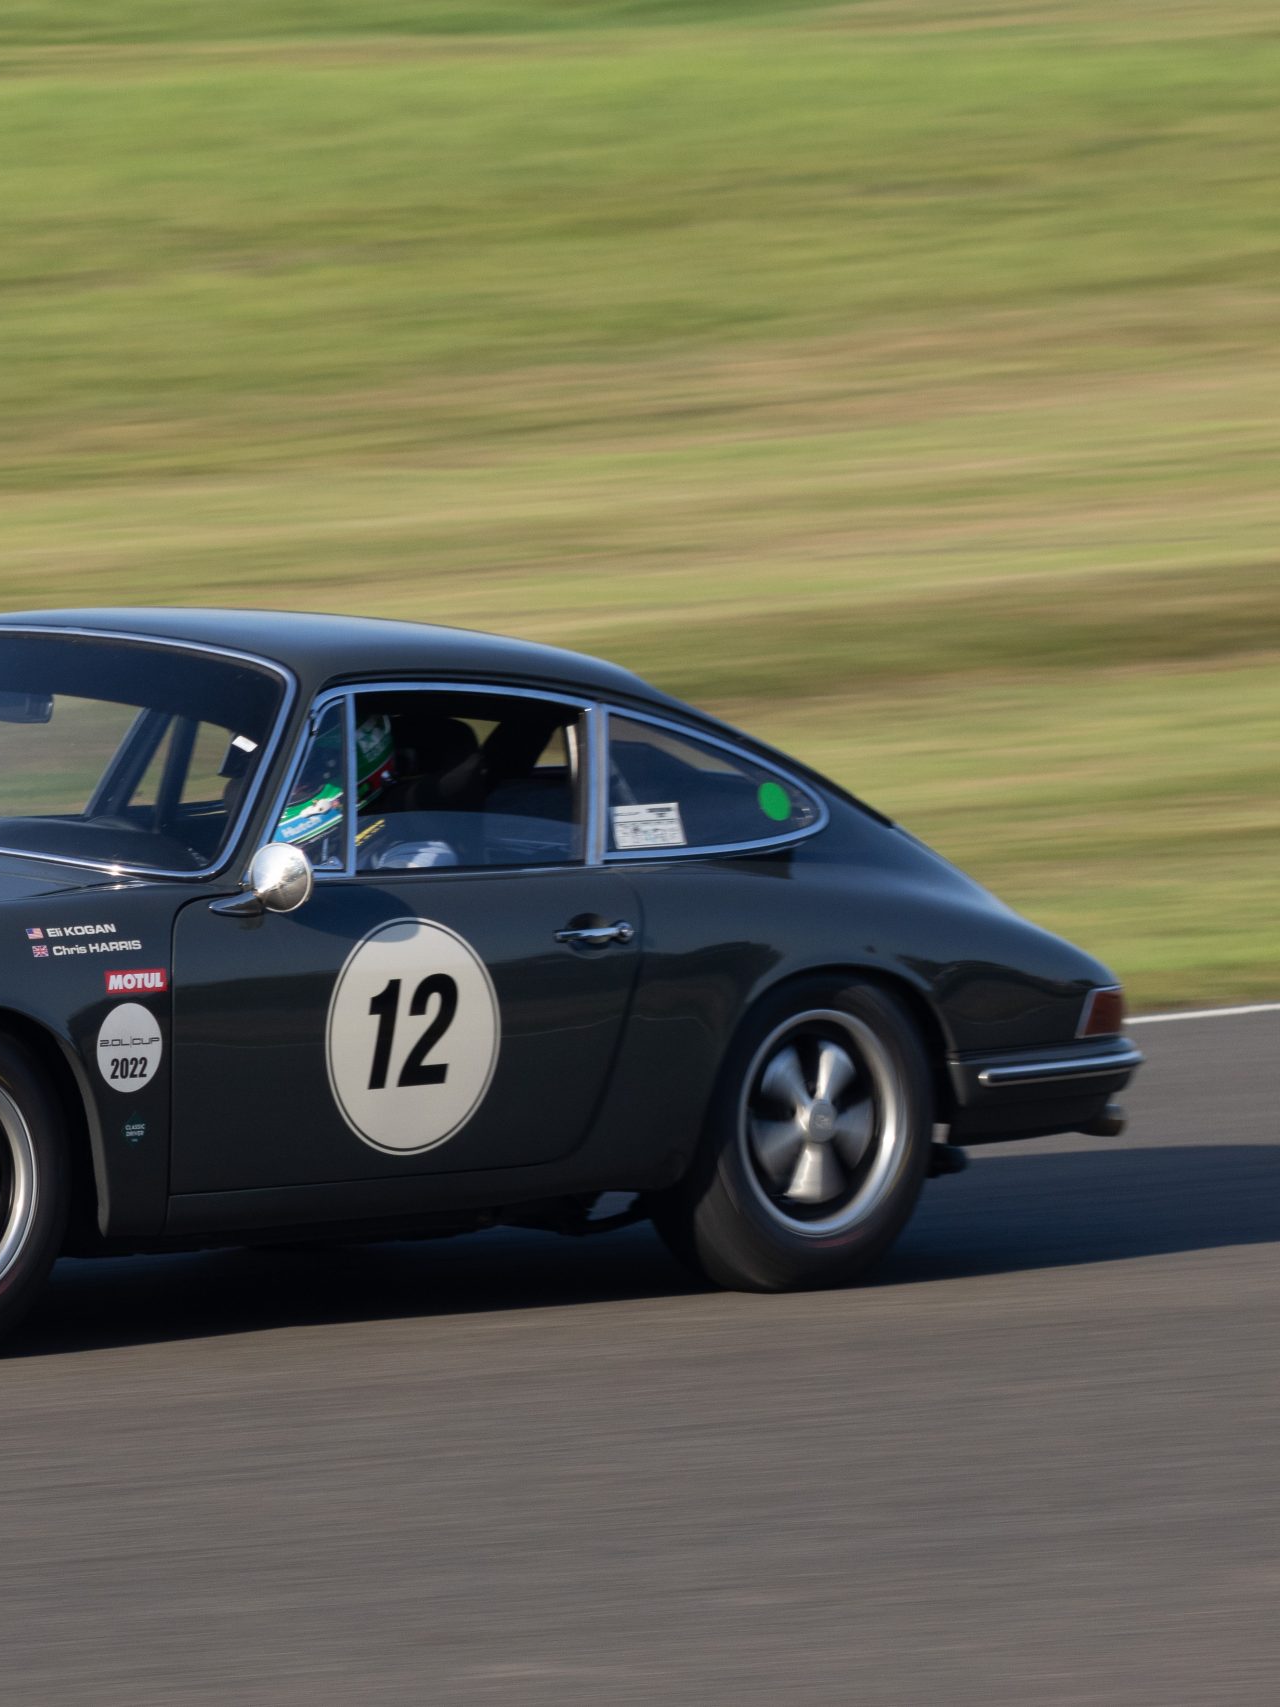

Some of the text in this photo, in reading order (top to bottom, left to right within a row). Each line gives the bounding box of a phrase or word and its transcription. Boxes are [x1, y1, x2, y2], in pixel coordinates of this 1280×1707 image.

[46, 923, 117, 938] Eli KOGAN
[52, 939, 143, 956] Chris HARRIS
[108, 972, 164, 991] MOTUL
[368, 973, 459, 1090] 12
[110, 1056, 148, 1080] 2022
